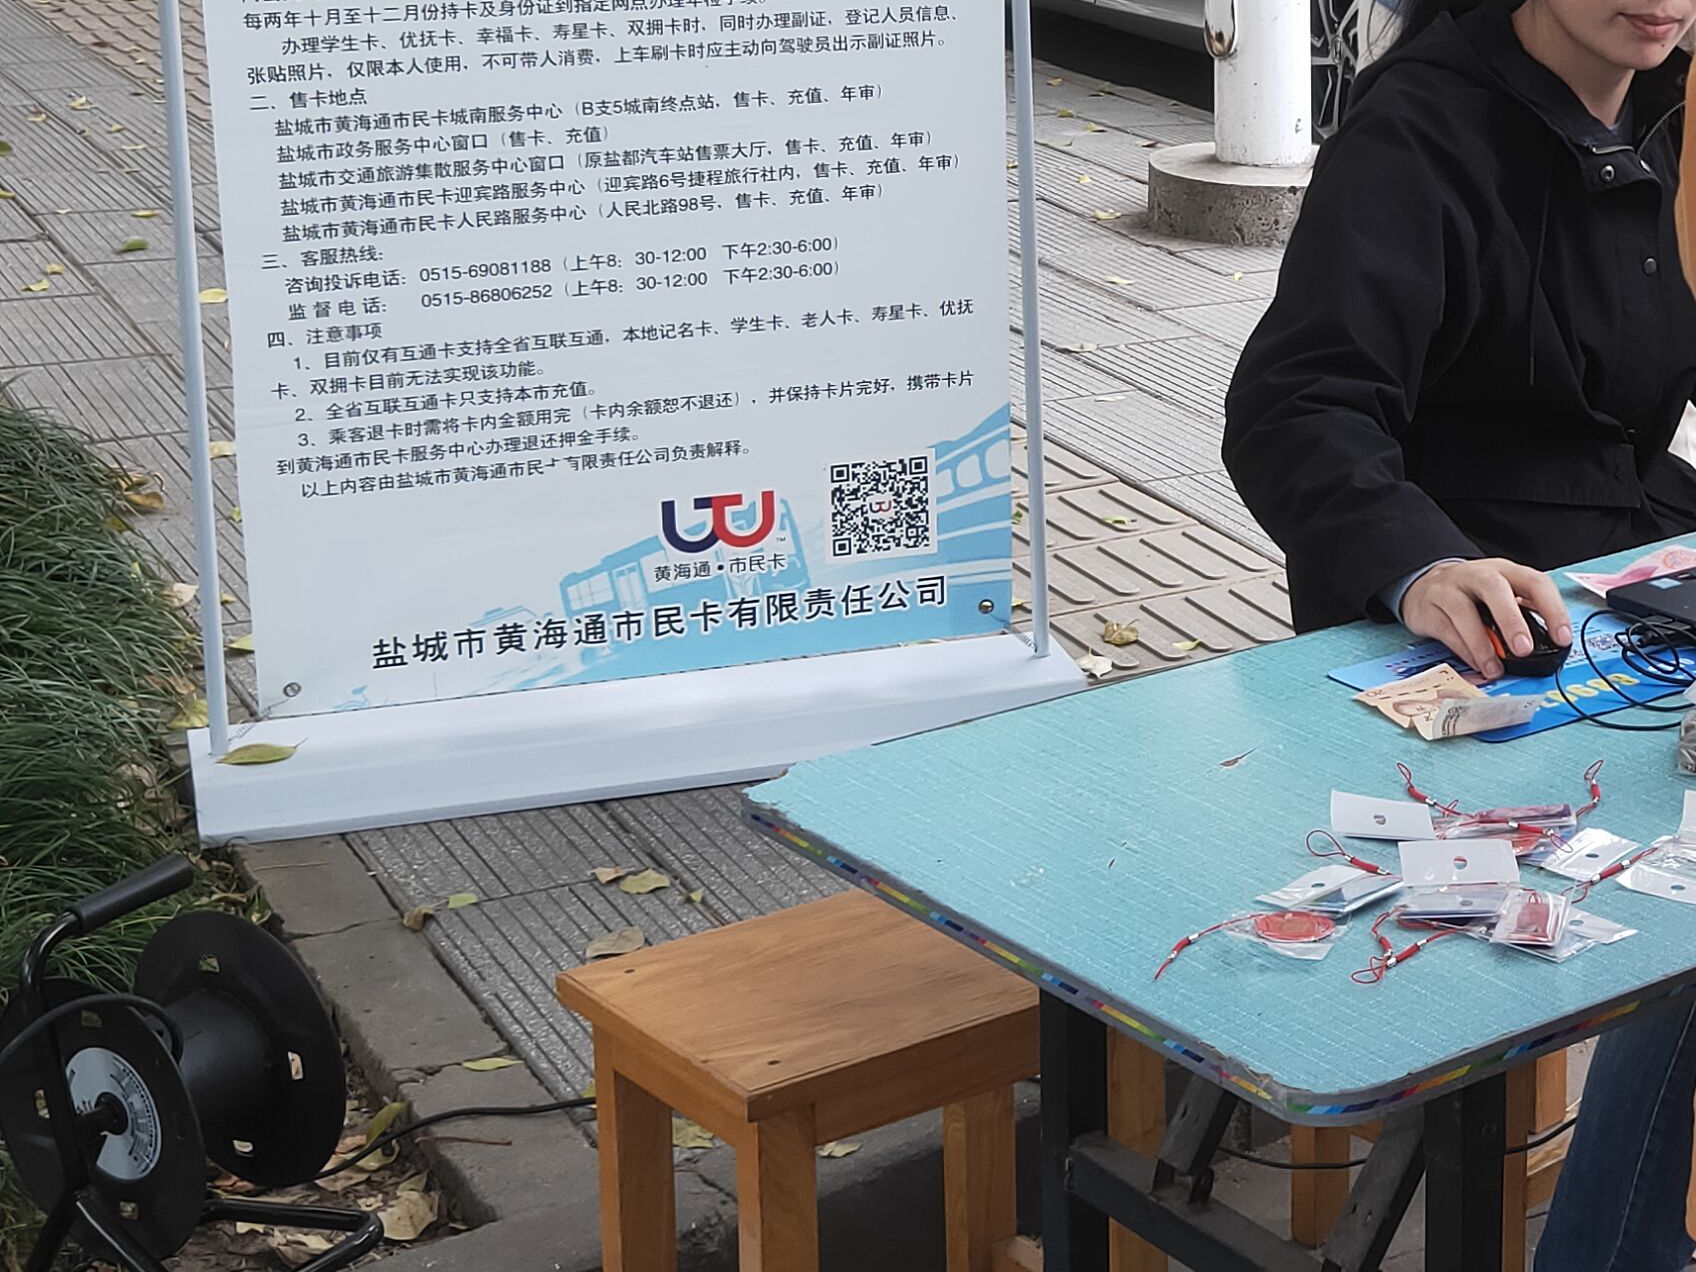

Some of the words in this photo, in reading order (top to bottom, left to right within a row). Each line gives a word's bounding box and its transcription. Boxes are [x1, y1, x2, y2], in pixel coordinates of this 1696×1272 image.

[371, 575, 948, 670] 盐城市黄海通市民卡有限责任公司
